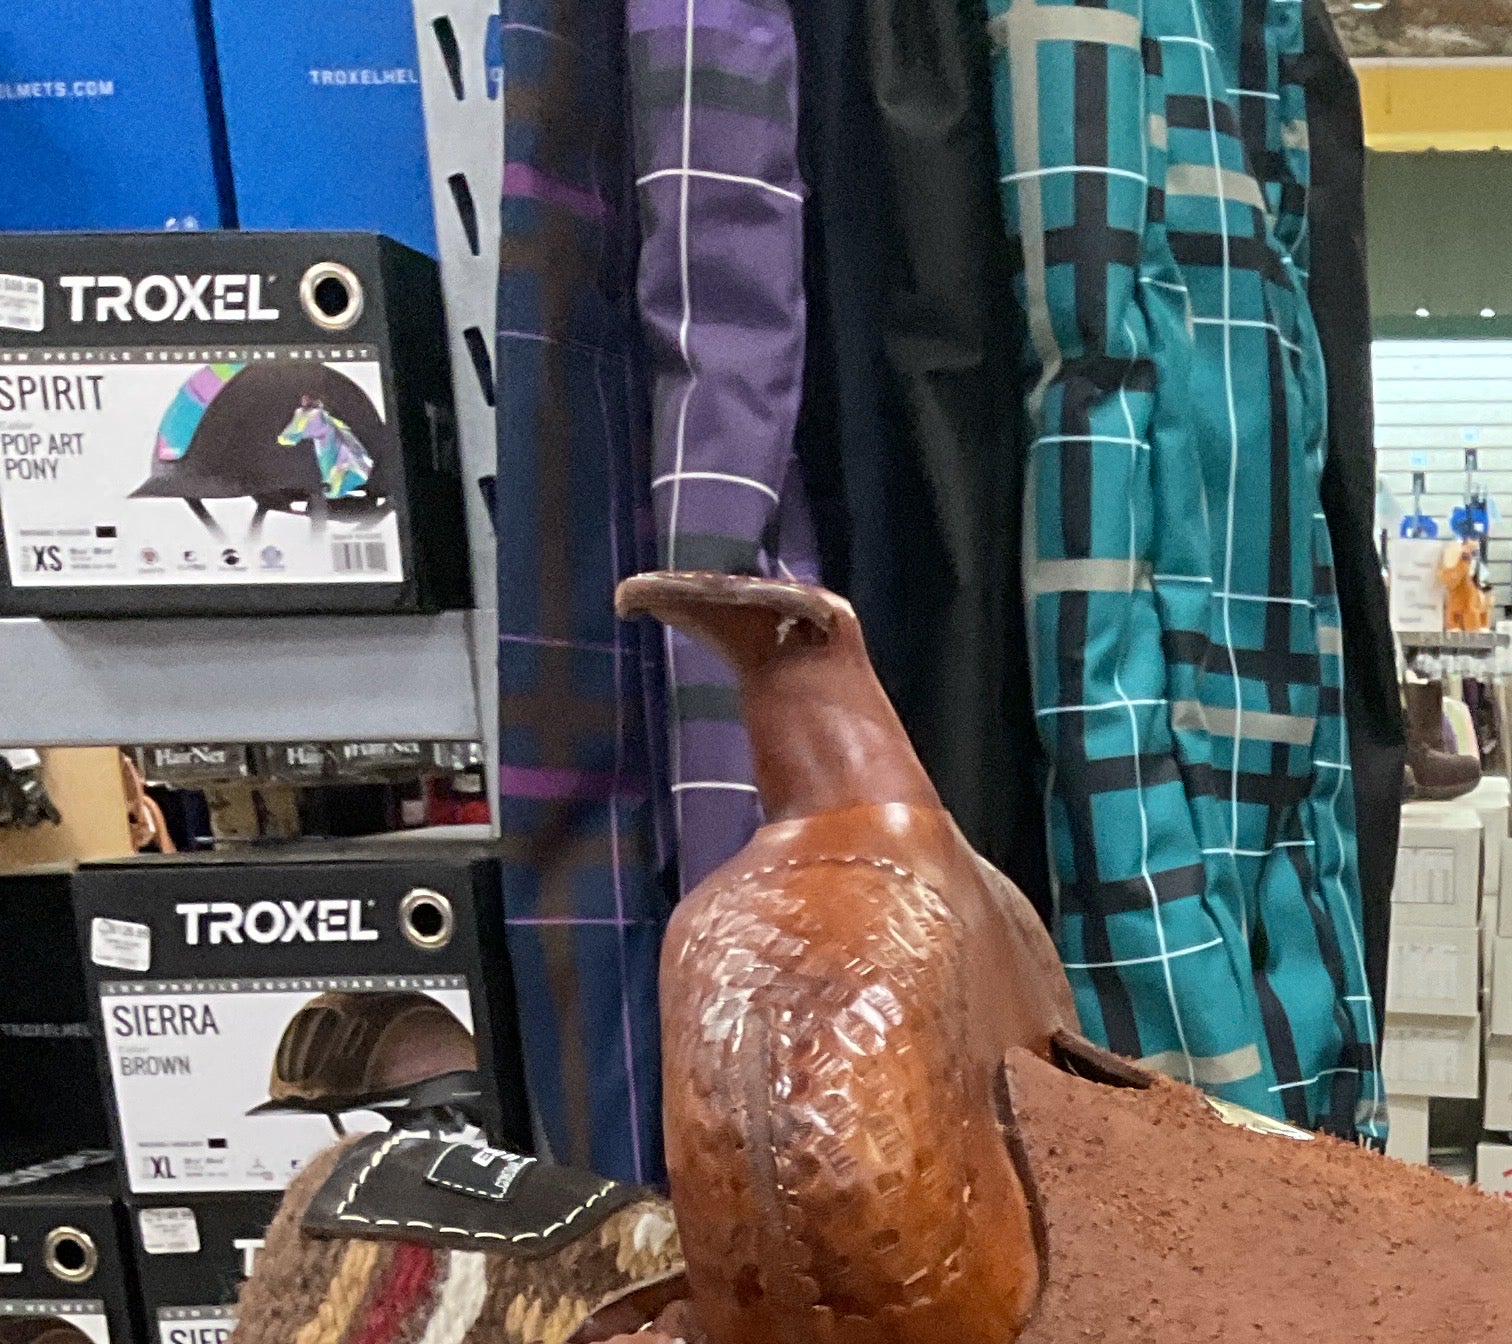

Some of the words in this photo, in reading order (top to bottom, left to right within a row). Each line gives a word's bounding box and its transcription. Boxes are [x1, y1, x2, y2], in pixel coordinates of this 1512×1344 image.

[59, 274, 280, 322] TROXEL
[0, 375, 103, 412] SPIRIT
[1, 433, 45, 456] POP
[49, 432, 84, 456] ART
[5, 457, 59, 480] PONY
[32, 545, 63, 572] XS
[176, 899, 379, 945] TROXEL
[112, 1003, 220, 1037] SIERRA
[119, 1055, 191, 1077] BROWN
[149, 1156, 177, 1179] XL
